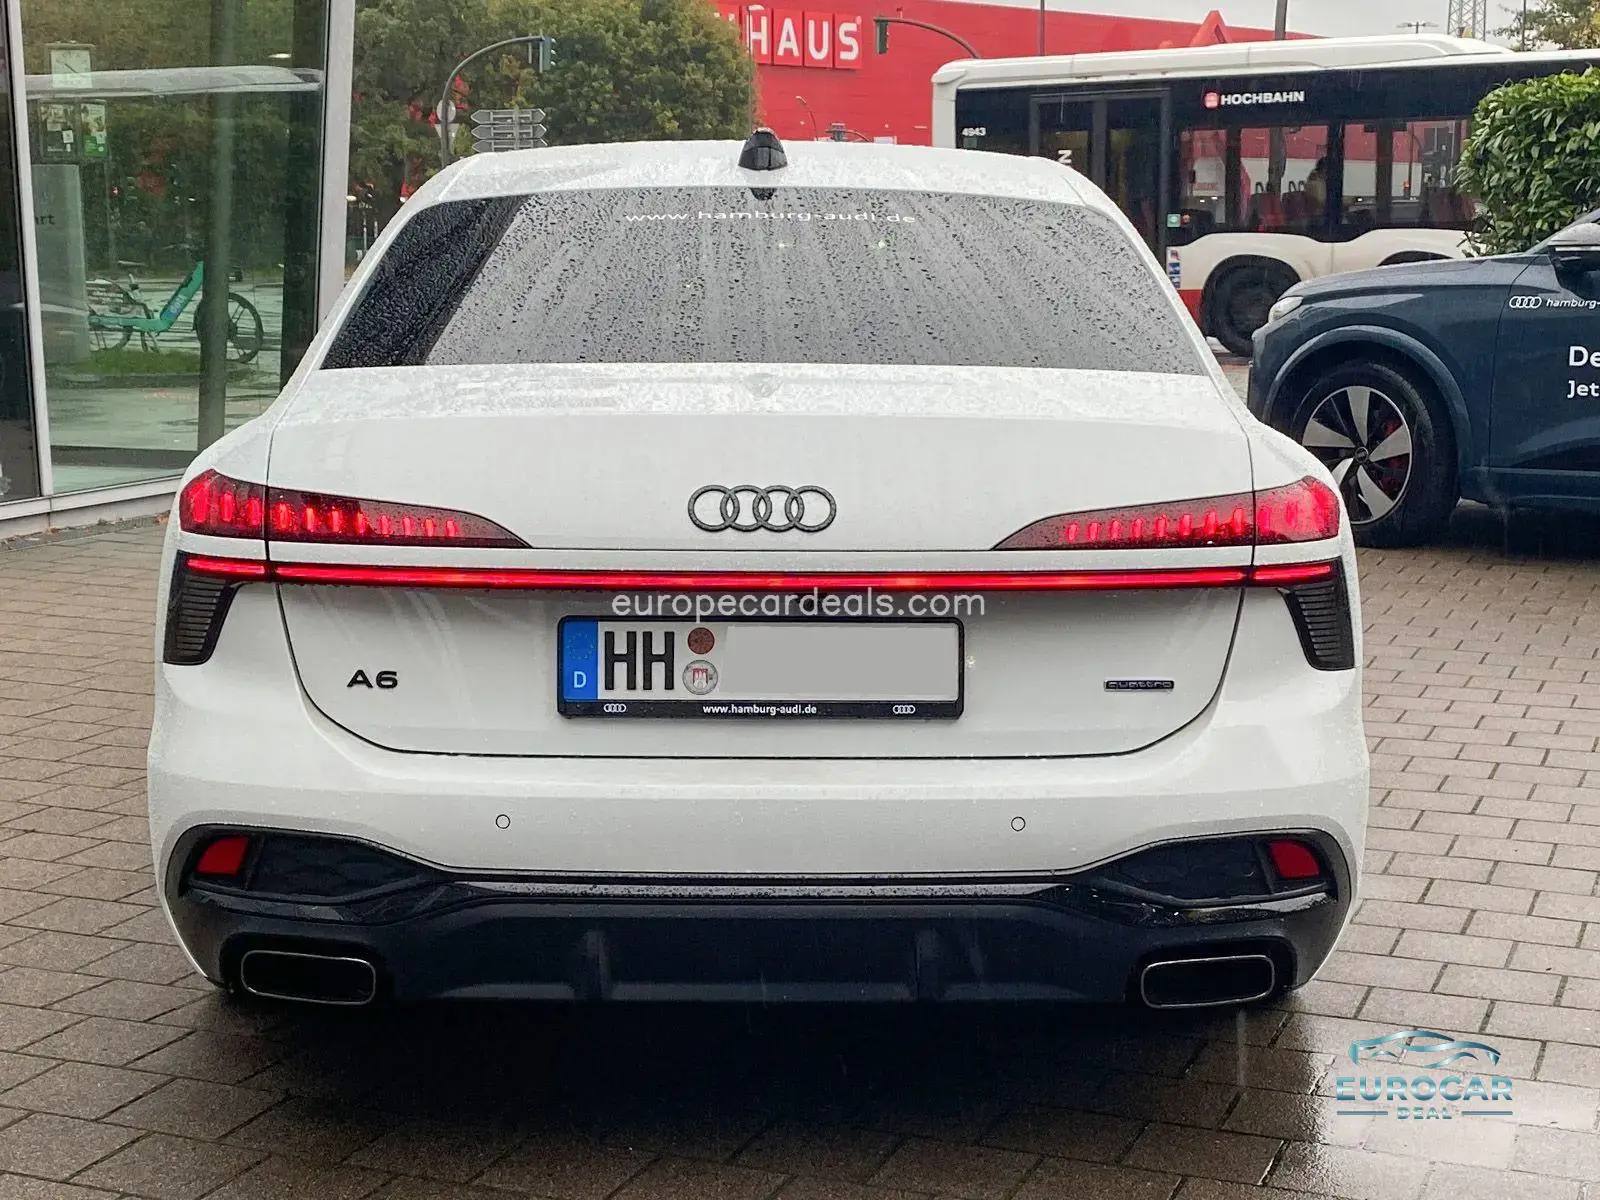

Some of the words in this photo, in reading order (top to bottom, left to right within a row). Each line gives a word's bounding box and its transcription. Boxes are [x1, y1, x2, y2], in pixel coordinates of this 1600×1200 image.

[714, 12, 861, 61] HAUS
[1220, 91, 1305, 105] HOCHBAHN
[962, 127, 986, 137] 4943
[625, 210, 917, 223] www.hamburg-audi.de
[1567, 380, 1600, 399] Jet
[604, 631, 675, 690] HH
[346, 669, 398, 689] A6
[573, 671, 587, 688] D
[1106, 680, 1174, 689] quattro
[702, 704, 817, 716] www.hamburg-audi.de
